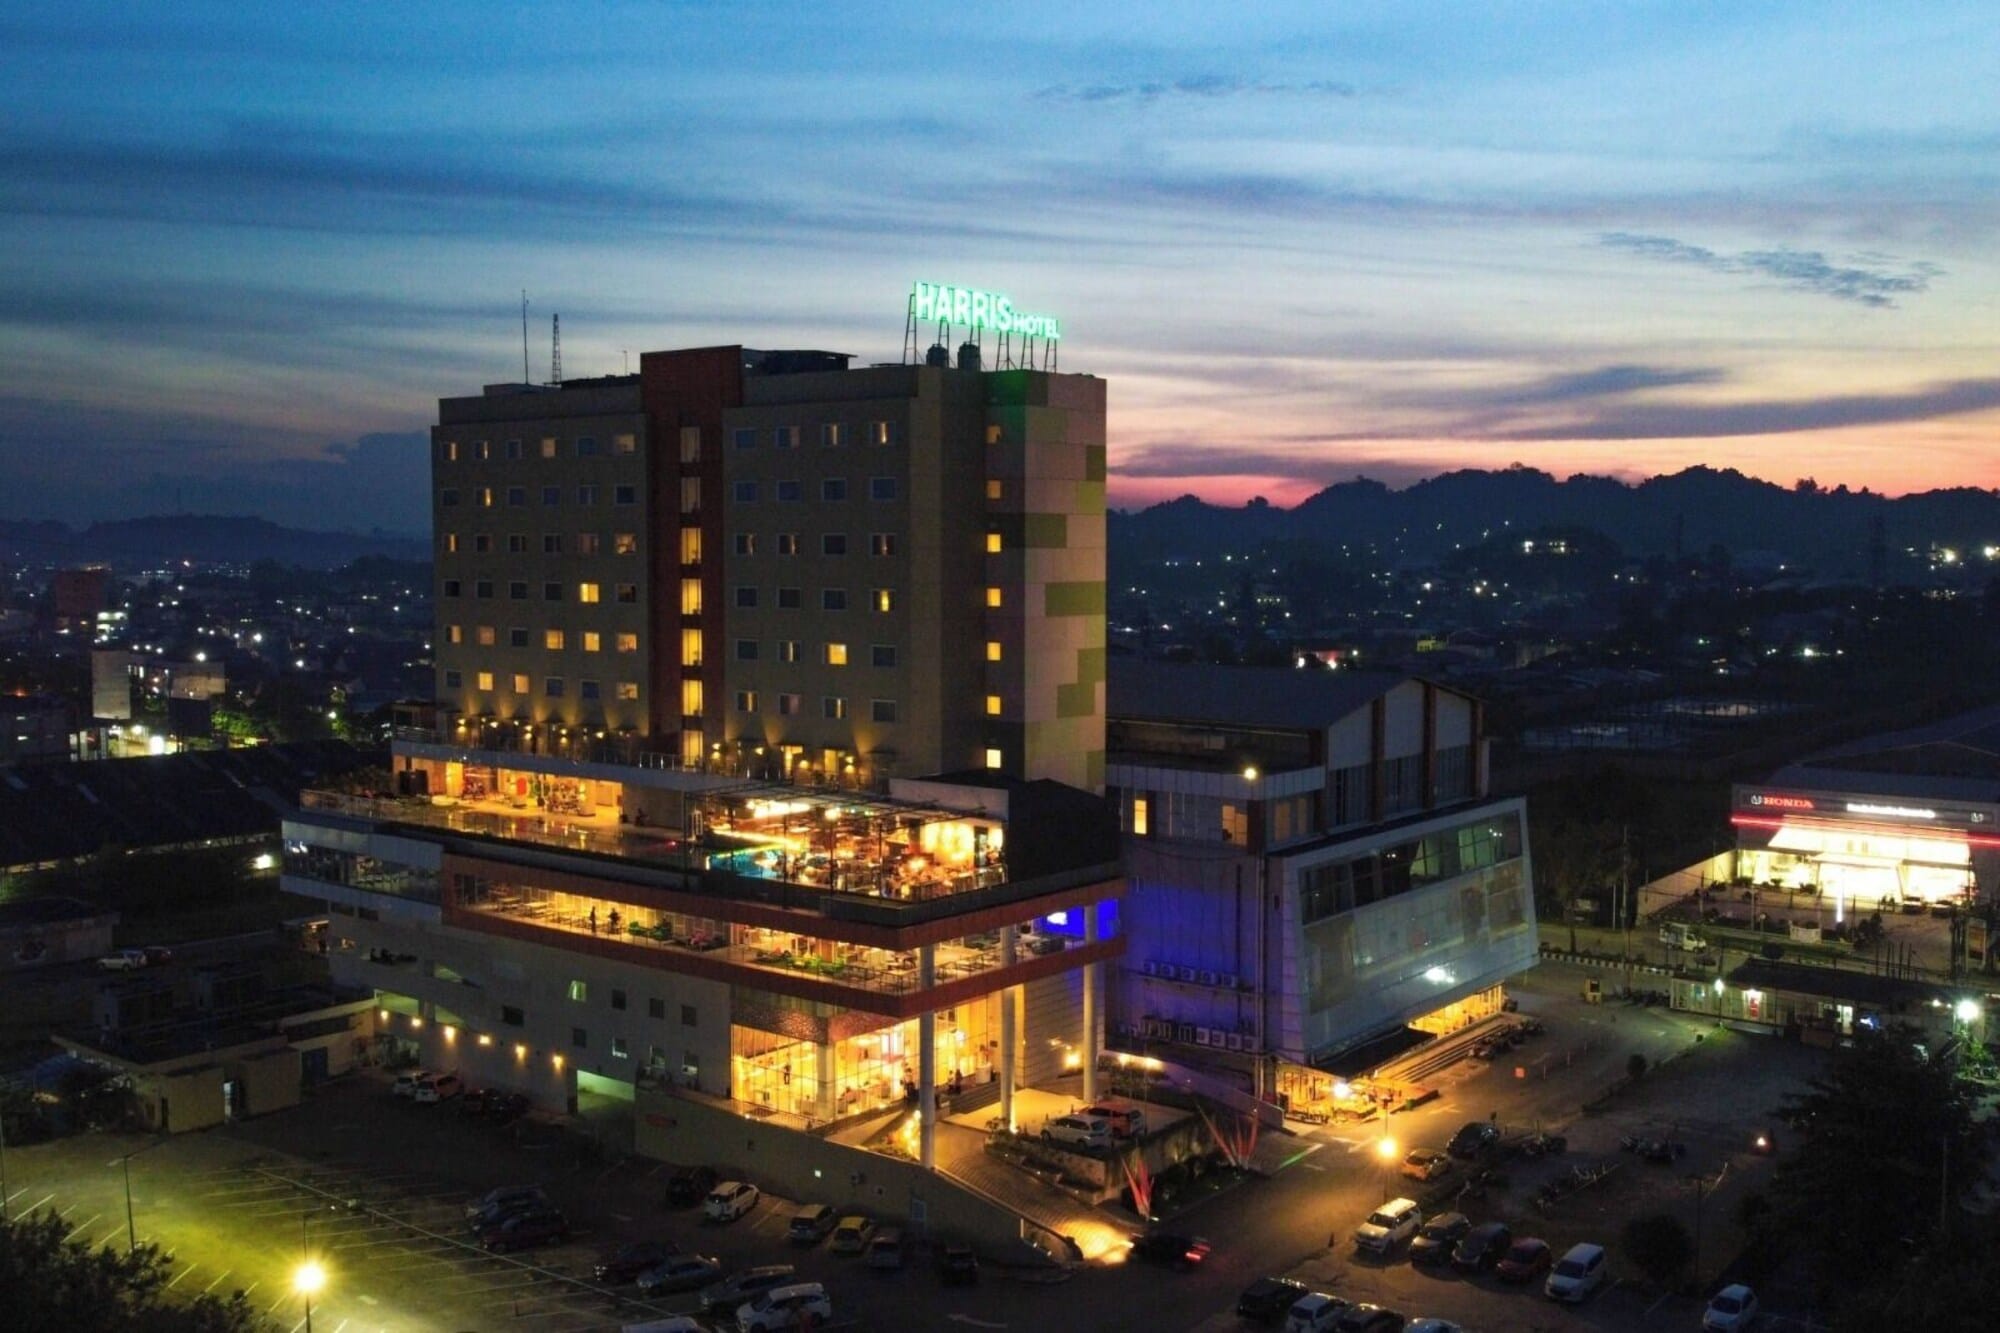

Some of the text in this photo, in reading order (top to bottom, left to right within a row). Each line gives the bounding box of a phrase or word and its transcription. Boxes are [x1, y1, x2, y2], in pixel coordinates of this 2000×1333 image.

[915, 281, 1060, 339] HARRIS HOTEL
[1763, 796, 1814, 809] HONDA
